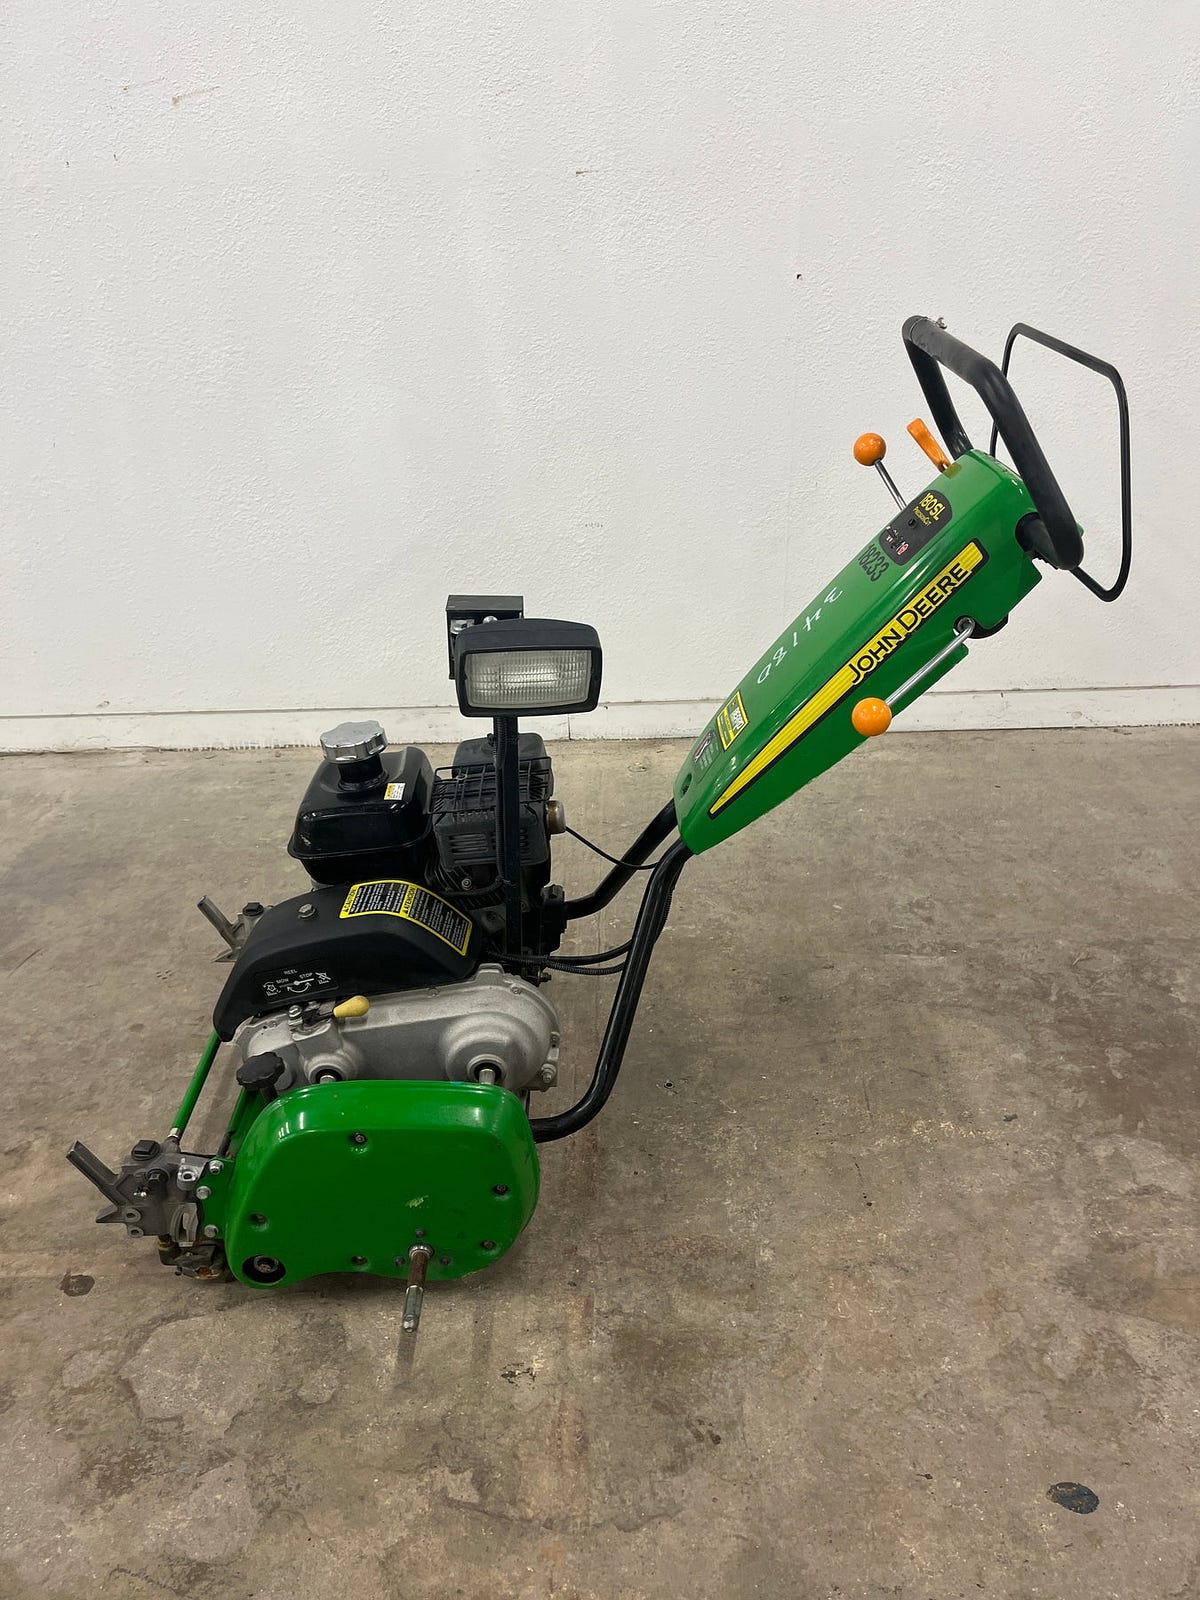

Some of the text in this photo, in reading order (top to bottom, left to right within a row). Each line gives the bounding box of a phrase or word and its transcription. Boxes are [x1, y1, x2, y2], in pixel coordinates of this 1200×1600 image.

[920, 492, 946, 521] 180SL
[858, 543, 890, 582] 18233
[848, 562, 969, 684] JOHN DEERE
